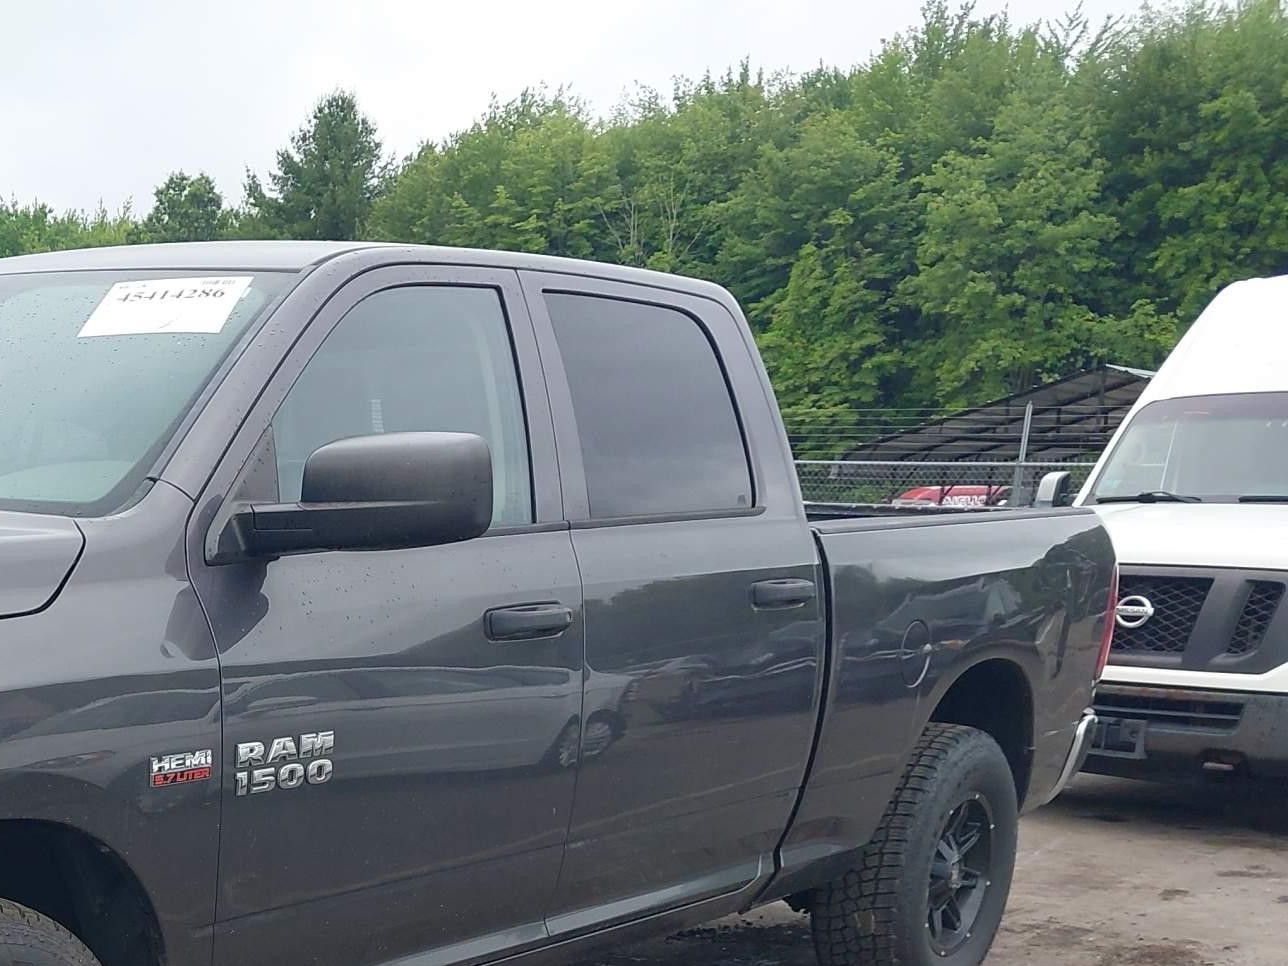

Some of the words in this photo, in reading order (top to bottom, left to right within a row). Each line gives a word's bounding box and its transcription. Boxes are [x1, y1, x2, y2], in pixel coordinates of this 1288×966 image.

[117, 288, 226, 302] 45414286
[1117, 607, 1149, 615] NISSAN
[151, 749, 213, 773] HEMI
[236, 730, 335, 768] RAM
[235, 759, 334, 797] 1500
